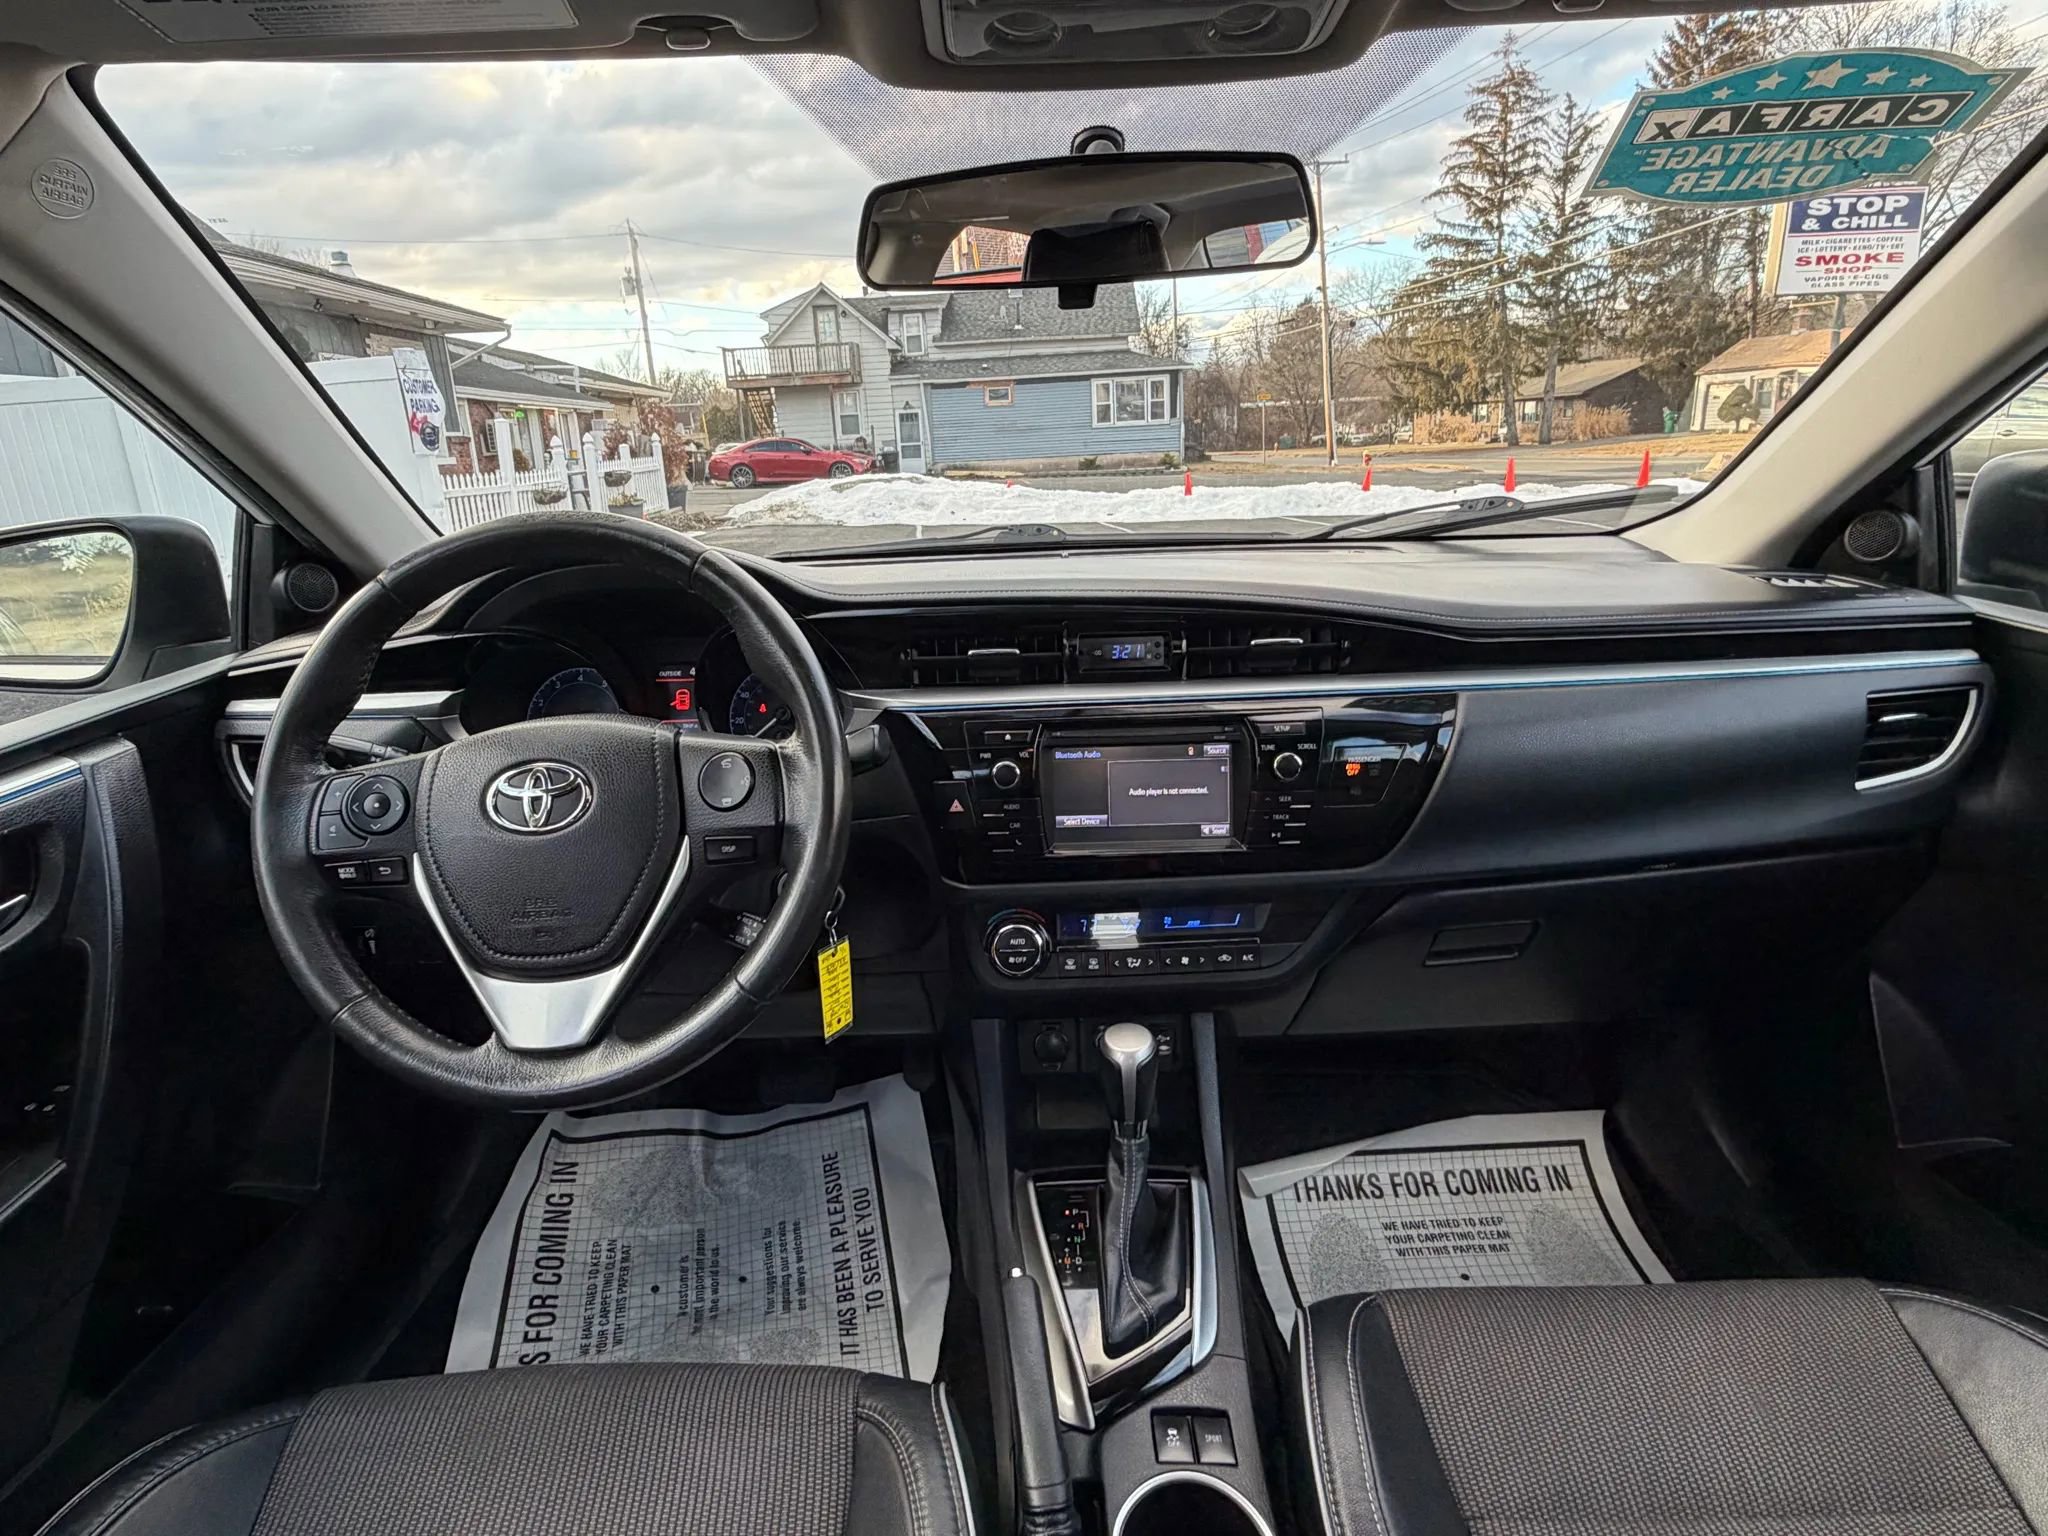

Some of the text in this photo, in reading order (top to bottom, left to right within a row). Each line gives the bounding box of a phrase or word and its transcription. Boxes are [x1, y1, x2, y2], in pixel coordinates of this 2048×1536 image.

[40, 174, 88, 196] CURTAIN
[42, 186, 85, 206] AIRBAG
[1807, 194, 1910, 216] STOP
[1801, 214, 1909, 231] & CHILL
[1794, 252, 1905, 267] SMOKE
[1804, 273, 1890, 283] VAPORS E-CIGS
[1823, 265, 1872, 275] SHOP
[1849, 280, 1880, 288] PIPES
[402, 378, 437, 394] CUSTOMER
[409, 397, 440, 413] PARKING
[1111, 644, 1142, 659] 3:21
[1055, 750, 1101, 759] Bluetooth Audio
[1207, 746, 1227, 755] Source
[1128, 787, 1146, 796] Audio
[1146, 787, 1162, 797] player
[1163, 787, 1168, 795] is
[1063, 816, 1100, 826] Select Device
[1010, 938, 1026, 946] AUTO
[1015, 956, 1027, 964] OFF
[1242, 953, 1254, 962] A/C
[550, 1161, 580, 1184] IN
[1388, 1170, 1441, 1199] FOR
[1443, 1165, 1542, 1197] COMING
[1544, 1164, 1574, 1193] IN
[1072, 1208, 1079, 1216] P
[1381, 1215, 1504, 1232] WE HAVE TRIED TO KEEP
[532, 1192, 575, 1286] COMING
[695, 1227, 706, 1257] person
[778, 1220, 788, 1255] service
[1384, 1229, 1511, 1245] YOUR CARPETING CLEAN
[821, 1150, 860, 1356] IT HAS BEEN A PLEASURE
[852, 1186, 885, 1313] TO SERVE YOU
[1395, 1242, 1511, 1258] WITH THIS PAPER MAT
[709, 1258, 720, 1269] to
[780, 1255, 791, 1272] our
[1075, 1256, 1083, 1265] D
[761, 1226, 778, 1317] Your suggestions for
[678, 1265, 690, 1310] customer
[693, 1258, 706, 1304] important
[708, 1269, 720, 1296] world
[794, 1264, 808, 1297] always
[578, 1240, 602, 1358] WE HAVE TRIED TO KEEP
[594, 1239, 618, 1356] YOUR CARPETING CLEAN
[611, 1244, 633, 1349] WITH THIS PAPER MAT
[708, 1298, 720, 1314] the
[522, 1294, 560, 1344] FOR
